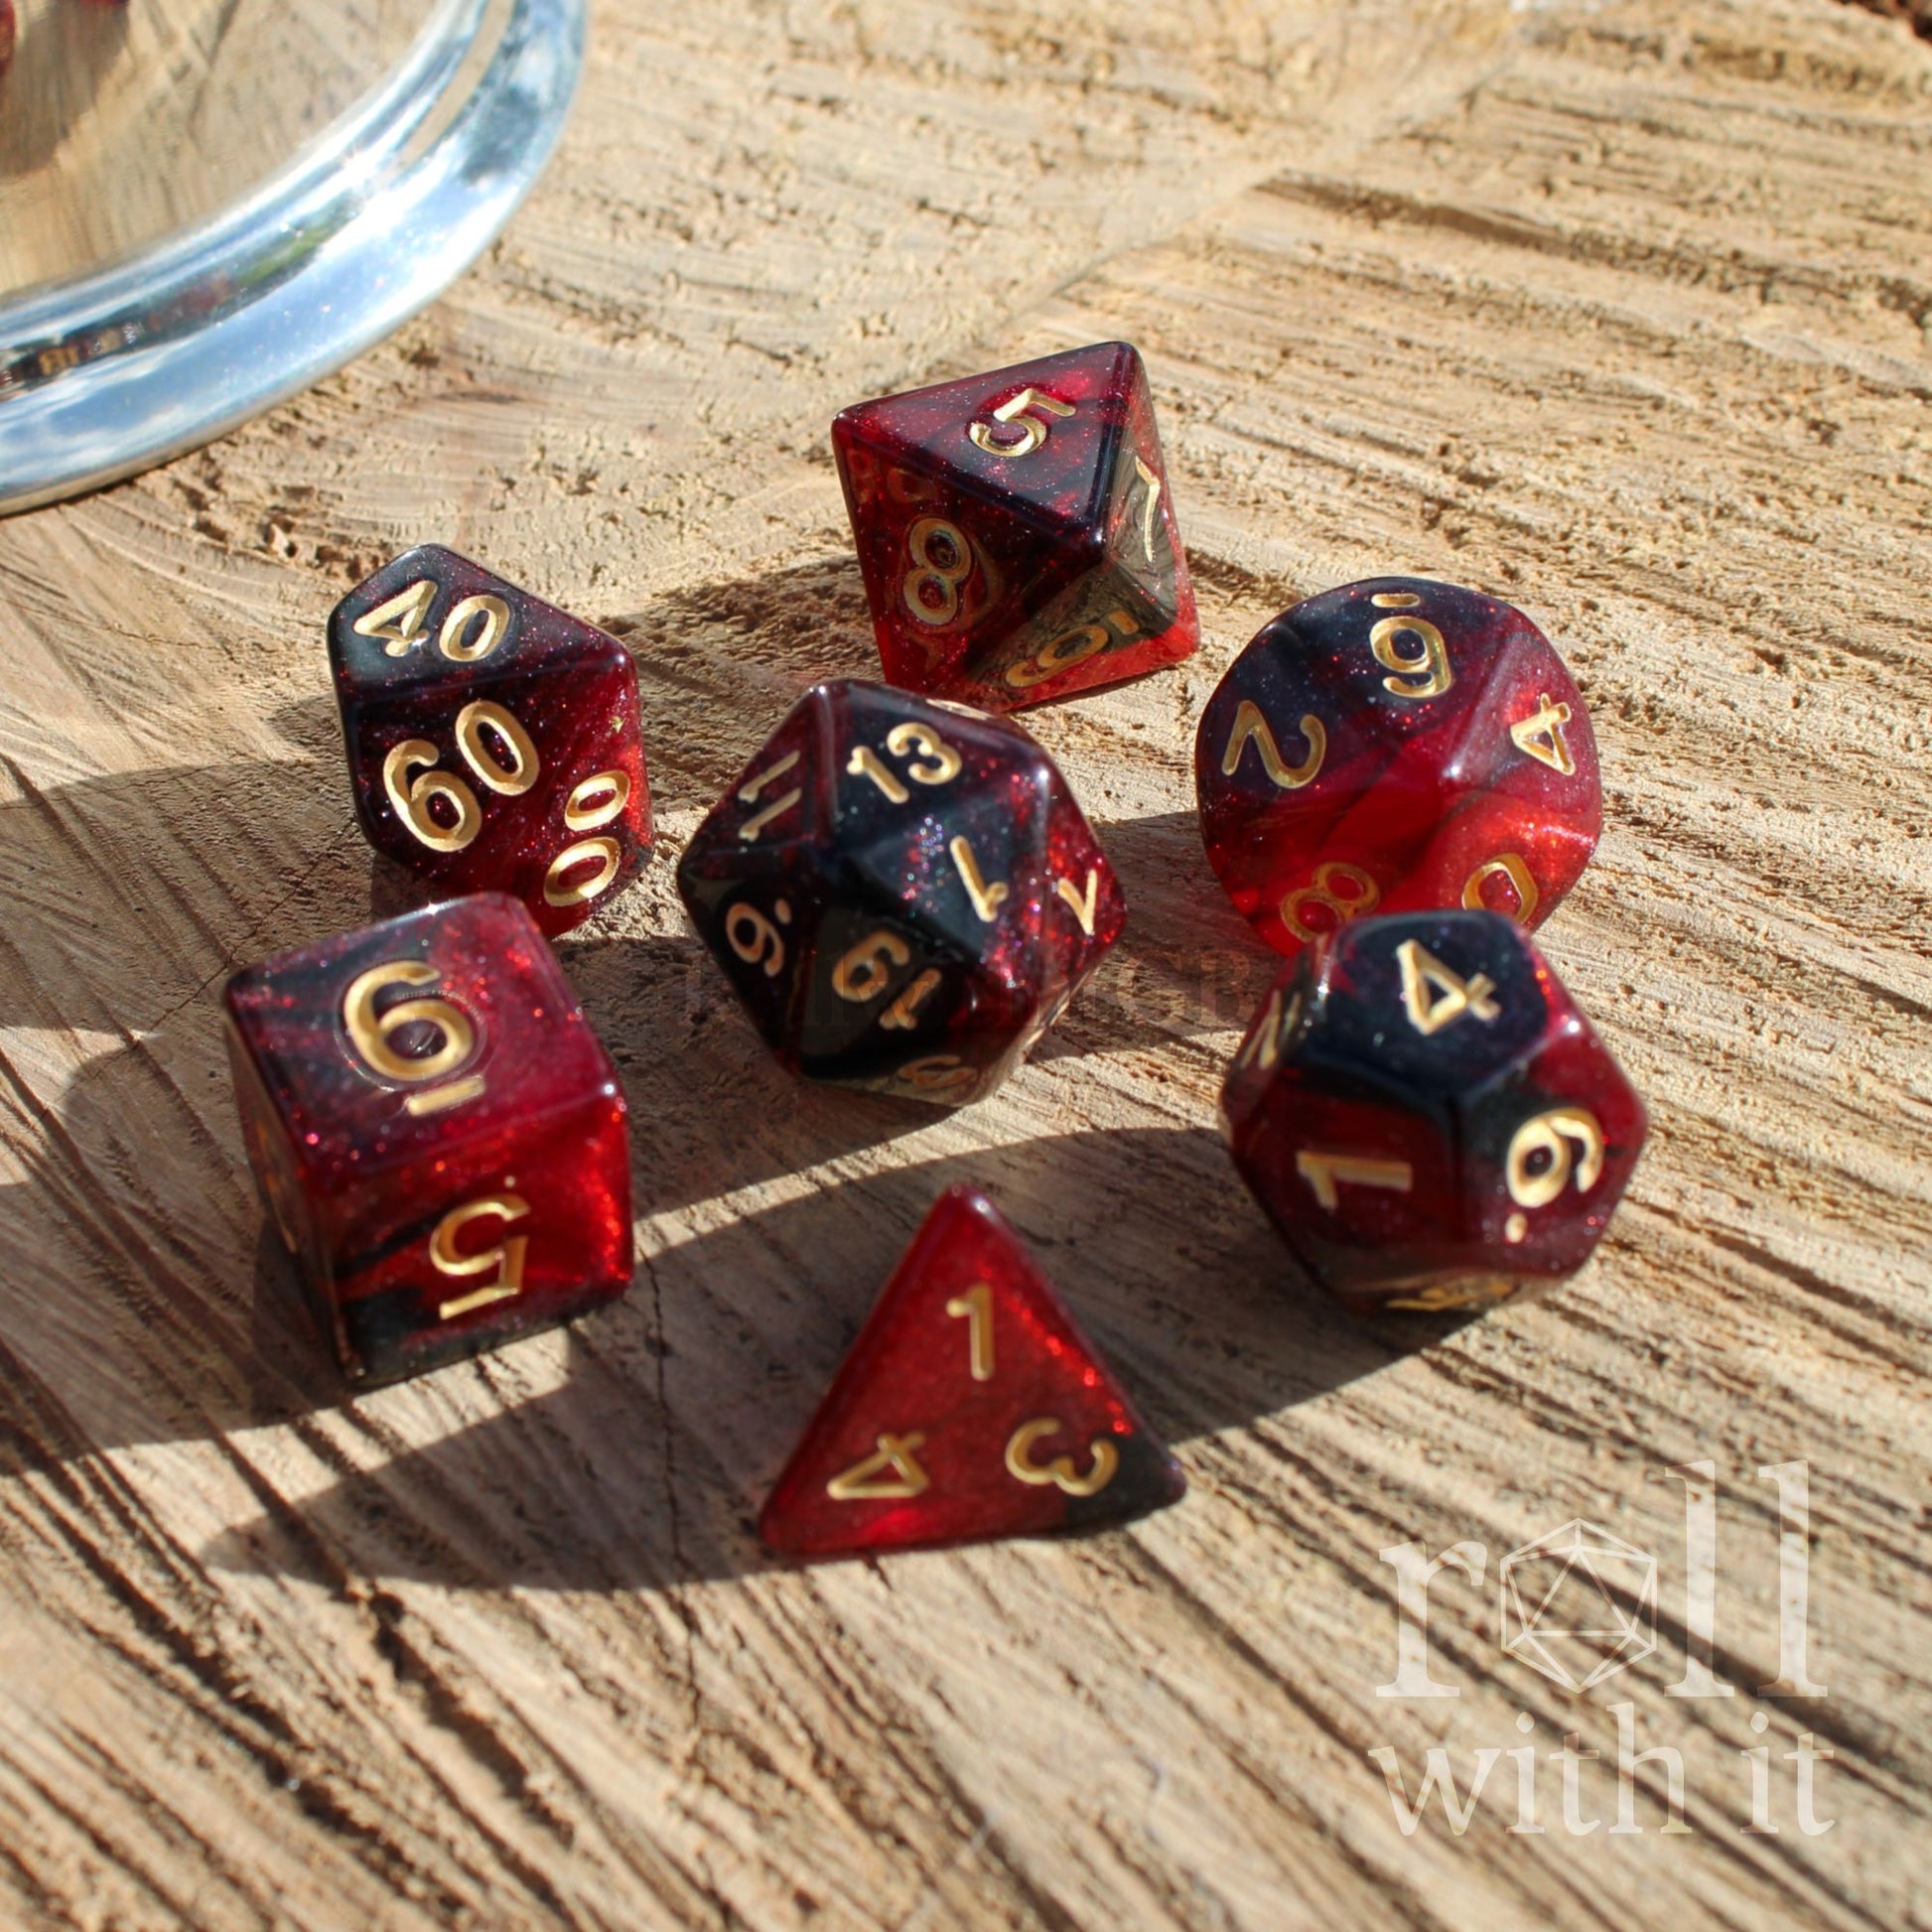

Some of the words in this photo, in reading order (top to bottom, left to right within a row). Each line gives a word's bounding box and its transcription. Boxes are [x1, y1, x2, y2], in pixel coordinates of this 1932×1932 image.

[969, 387, 1076, 458] 5
[902, 517, 972, 626] 8
[352, 579, 510, 662] 40
[383, 699, 540, 853] 60
[846, 722, 962, 804] 13
[1220, 699, 1326, 789] 2
[1510, 692, 1576, 776] 4
[738, 750, 802, 842] 11
[1396, 938, 1501, 1035] 4
[343, 960, 486, 1117] 6
[1296, 1151, 1413, 1210] 1
[430, 1194, 530, 1320] 5
[945, 1283, 993, 1382] 1
[827, 1433, 929, 1500] 4
[1005, 1418, 1119, 1497] 3
